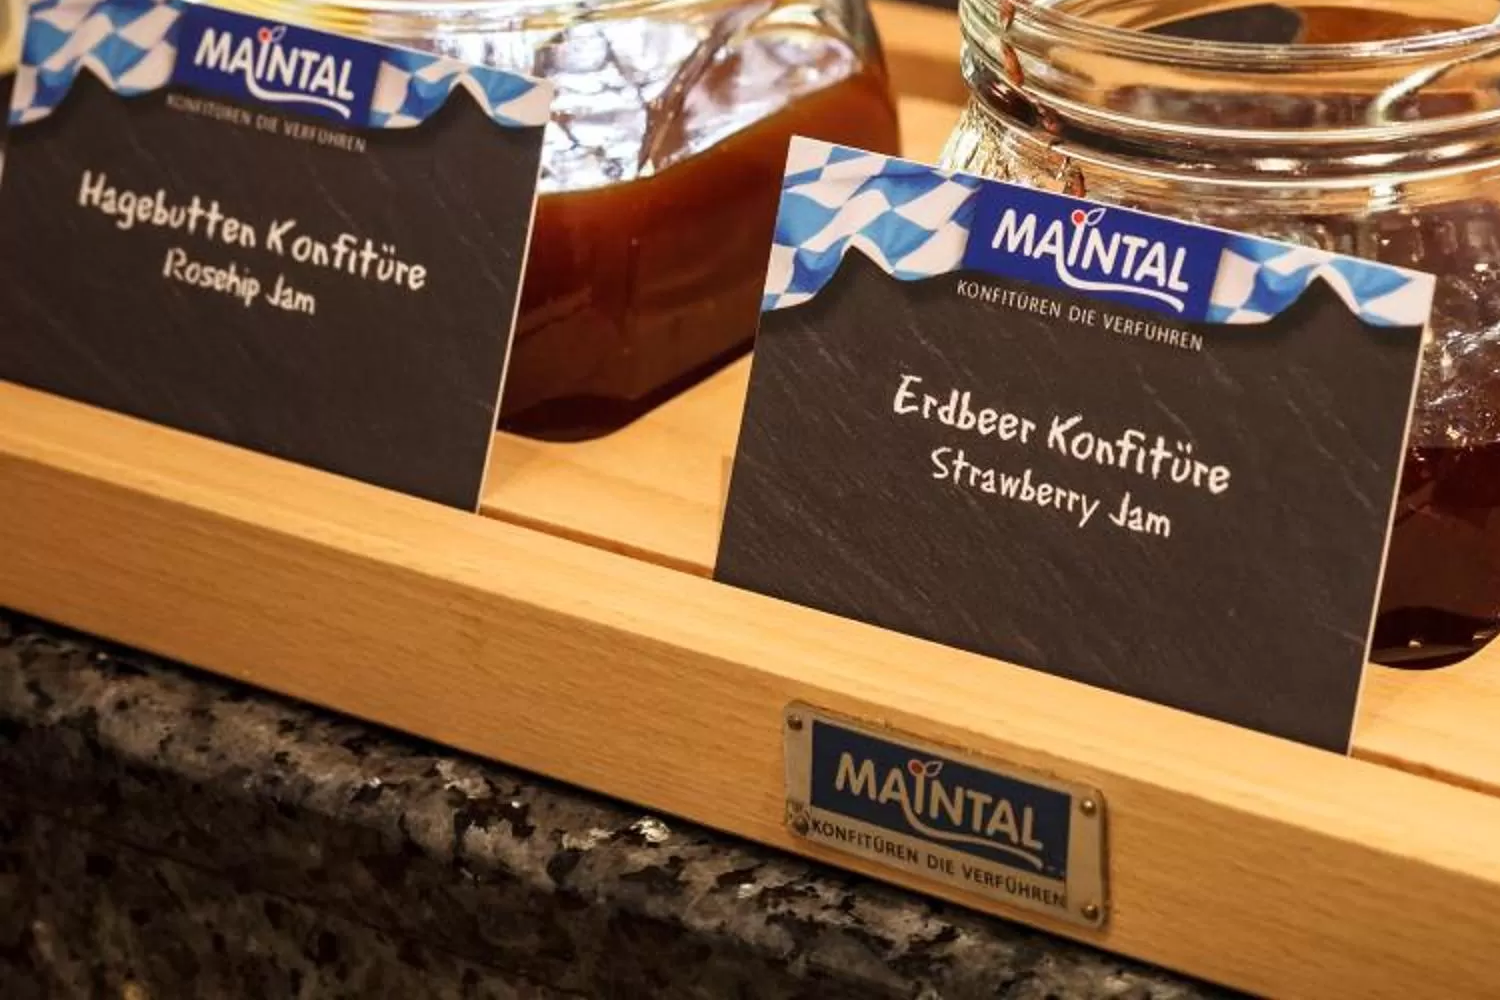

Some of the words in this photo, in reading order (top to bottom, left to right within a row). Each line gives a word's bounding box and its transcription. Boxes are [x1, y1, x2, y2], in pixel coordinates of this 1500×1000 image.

[194, 27, 354, 119] MAINTAL
[79, 170, 257, 249] Hagebutten
[268, 219, 427, 291] Konfitüre
[991, 208, 1189, 313] MAINTAL
[162, 247, 260, 306] Rosehip
[266, 282, 316, 315] Jam
[957, 278, 1062, 319] KONFITÜREN
[1068, 305, 1097, 326] DIE
[893, 373, 1035, 445] Erdbeer
[1046, 414, 1232, 494] Konfitüre
[931, 446, 1100, 527] Strawberry
[1108, 492, 1172, 538] Jam
[812, 817, 919, 864] KONFITÜREN
[926, 852, 955, 876] DIE
[835, 752, 1044, 870] MAINTAL
